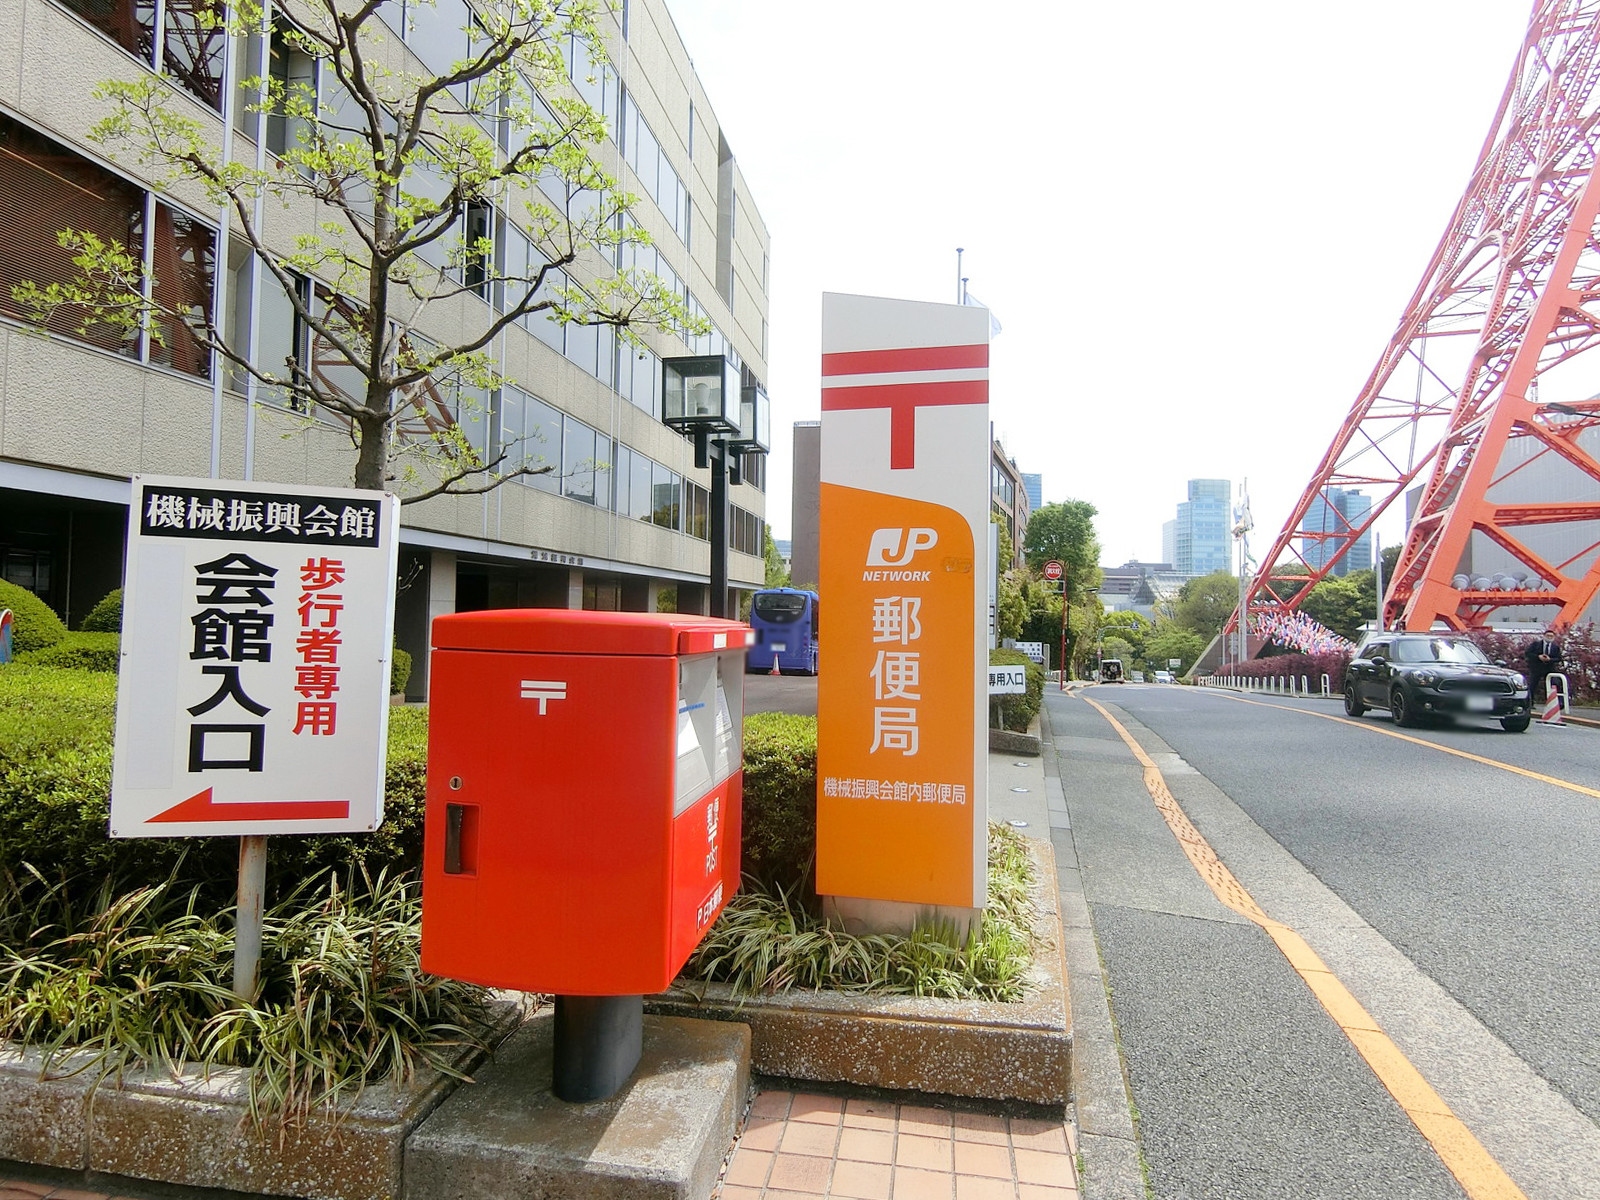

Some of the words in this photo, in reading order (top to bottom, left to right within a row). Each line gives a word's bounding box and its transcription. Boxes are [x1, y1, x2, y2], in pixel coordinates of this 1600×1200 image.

[146, 494, 376, 539] 機械振興会館
[863, 571, 931, 582] NETWORK
[187, 553, 279, 772] 会館入口
[293, 557, 346, 735] 歩行者専用
[869, 596, 921, 756] 郵便局
[824, 777, 966, 804] 機械振興会館内郵便局
